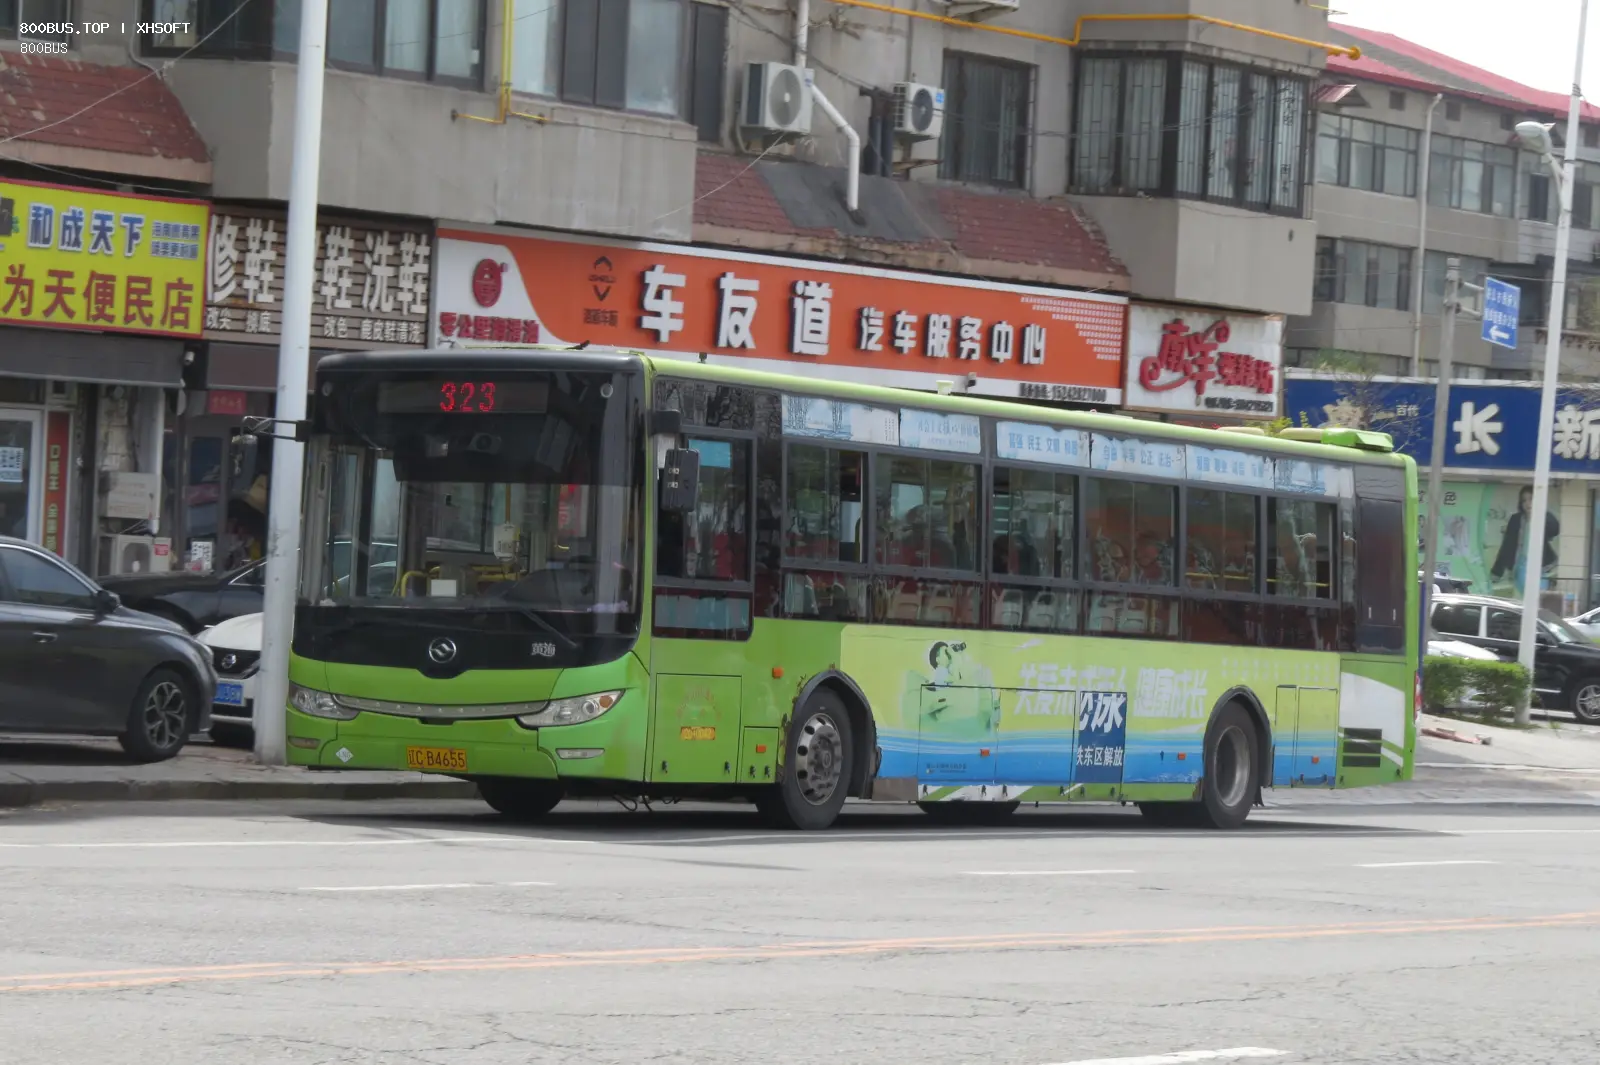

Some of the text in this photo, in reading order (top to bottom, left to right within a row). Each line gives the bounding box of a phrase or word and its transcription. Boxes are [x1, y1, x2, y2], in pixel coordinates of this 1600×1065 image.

[27, 203, 145, 257] 和成天下
[207, 214, 431, 316] 修鞋鞋洗鞋
[640, 264, 1048, 365] 车友道 汽车服务中心
[440, 382, 496, 412] 323
